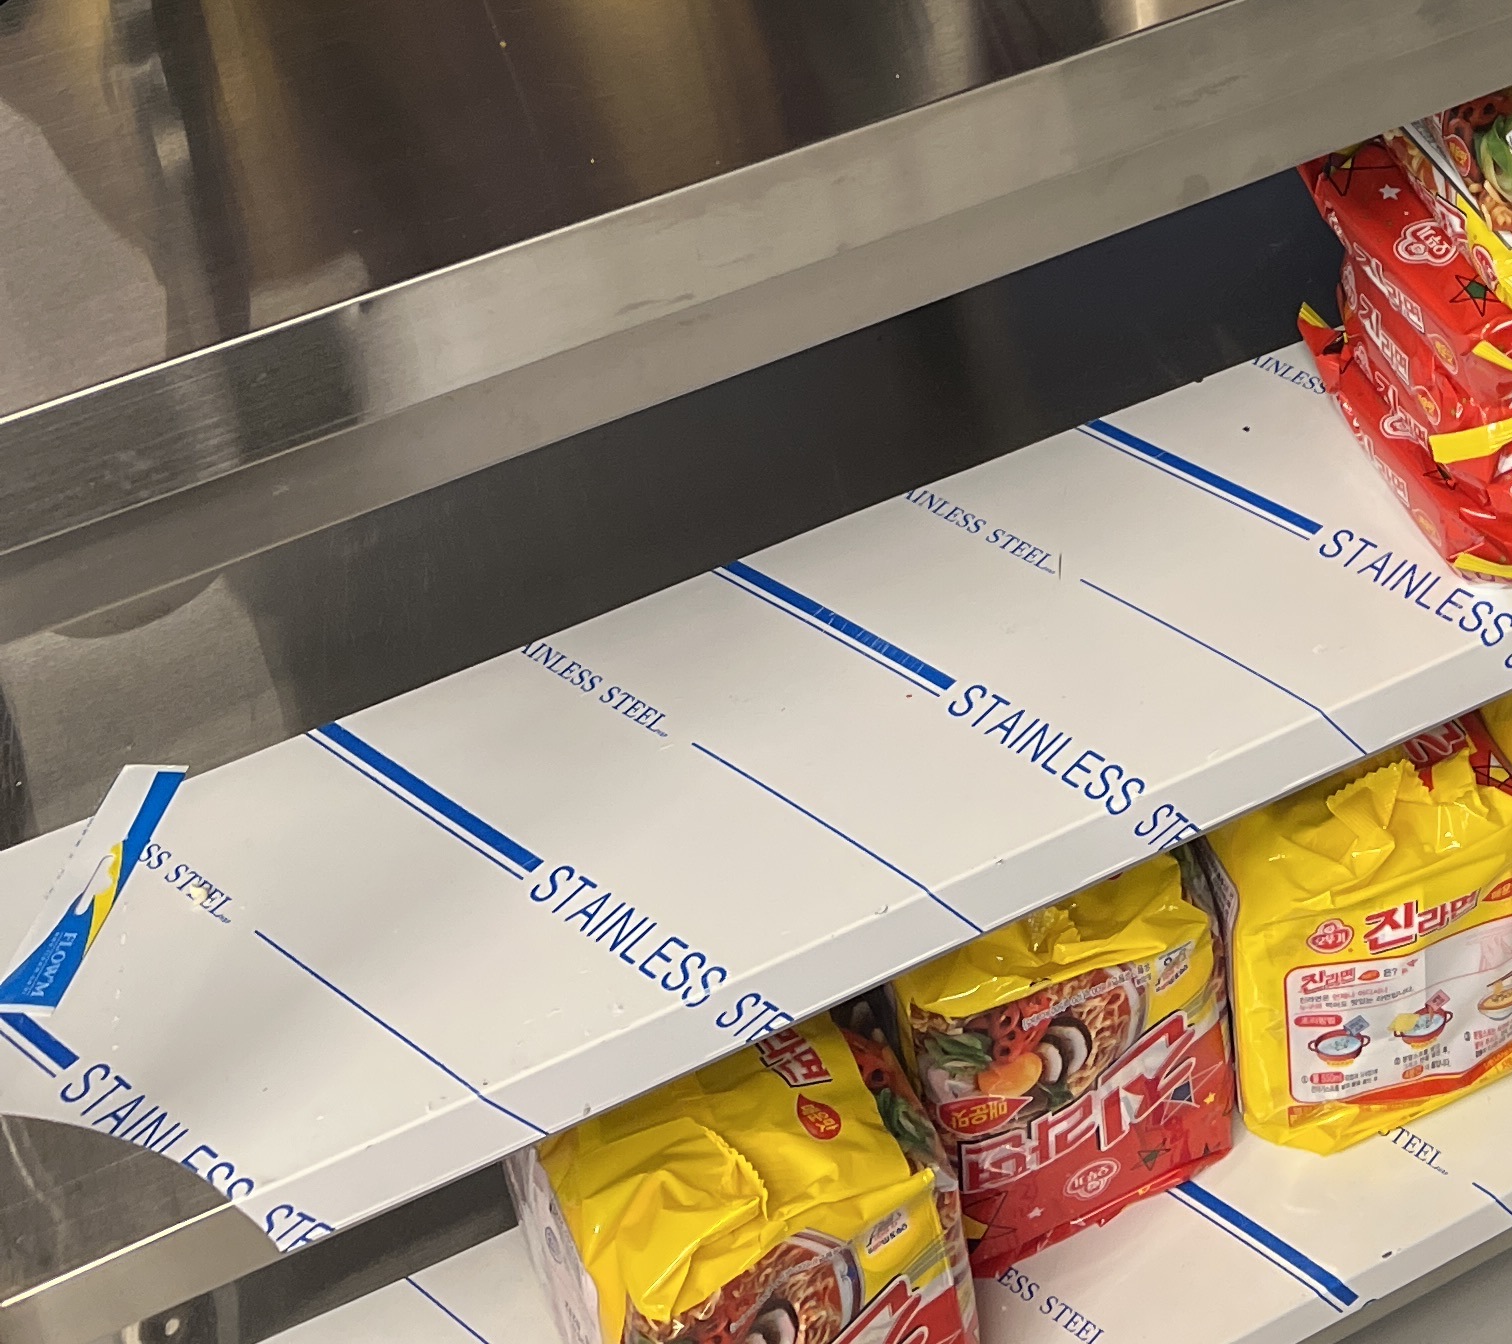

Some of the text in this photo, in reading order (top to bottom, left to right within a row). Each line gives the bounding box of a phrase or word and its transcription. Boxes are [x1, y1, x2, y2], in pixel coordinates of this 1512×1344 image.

[985, 523, 1051, 571] STEEL
[598, 685, 662, 733] STEEL
[947, 684, 1149, 817] STAINLESS
[529, 863, 733, 1010] STAINLESS
[1314, 929, 1350, 948] 오뚜기
[1363, 887, 1482, 955] 진라면
[950, 1100, 1009, 1130] 매운맛
[959, 1011, 1197, 1194] 진라면
